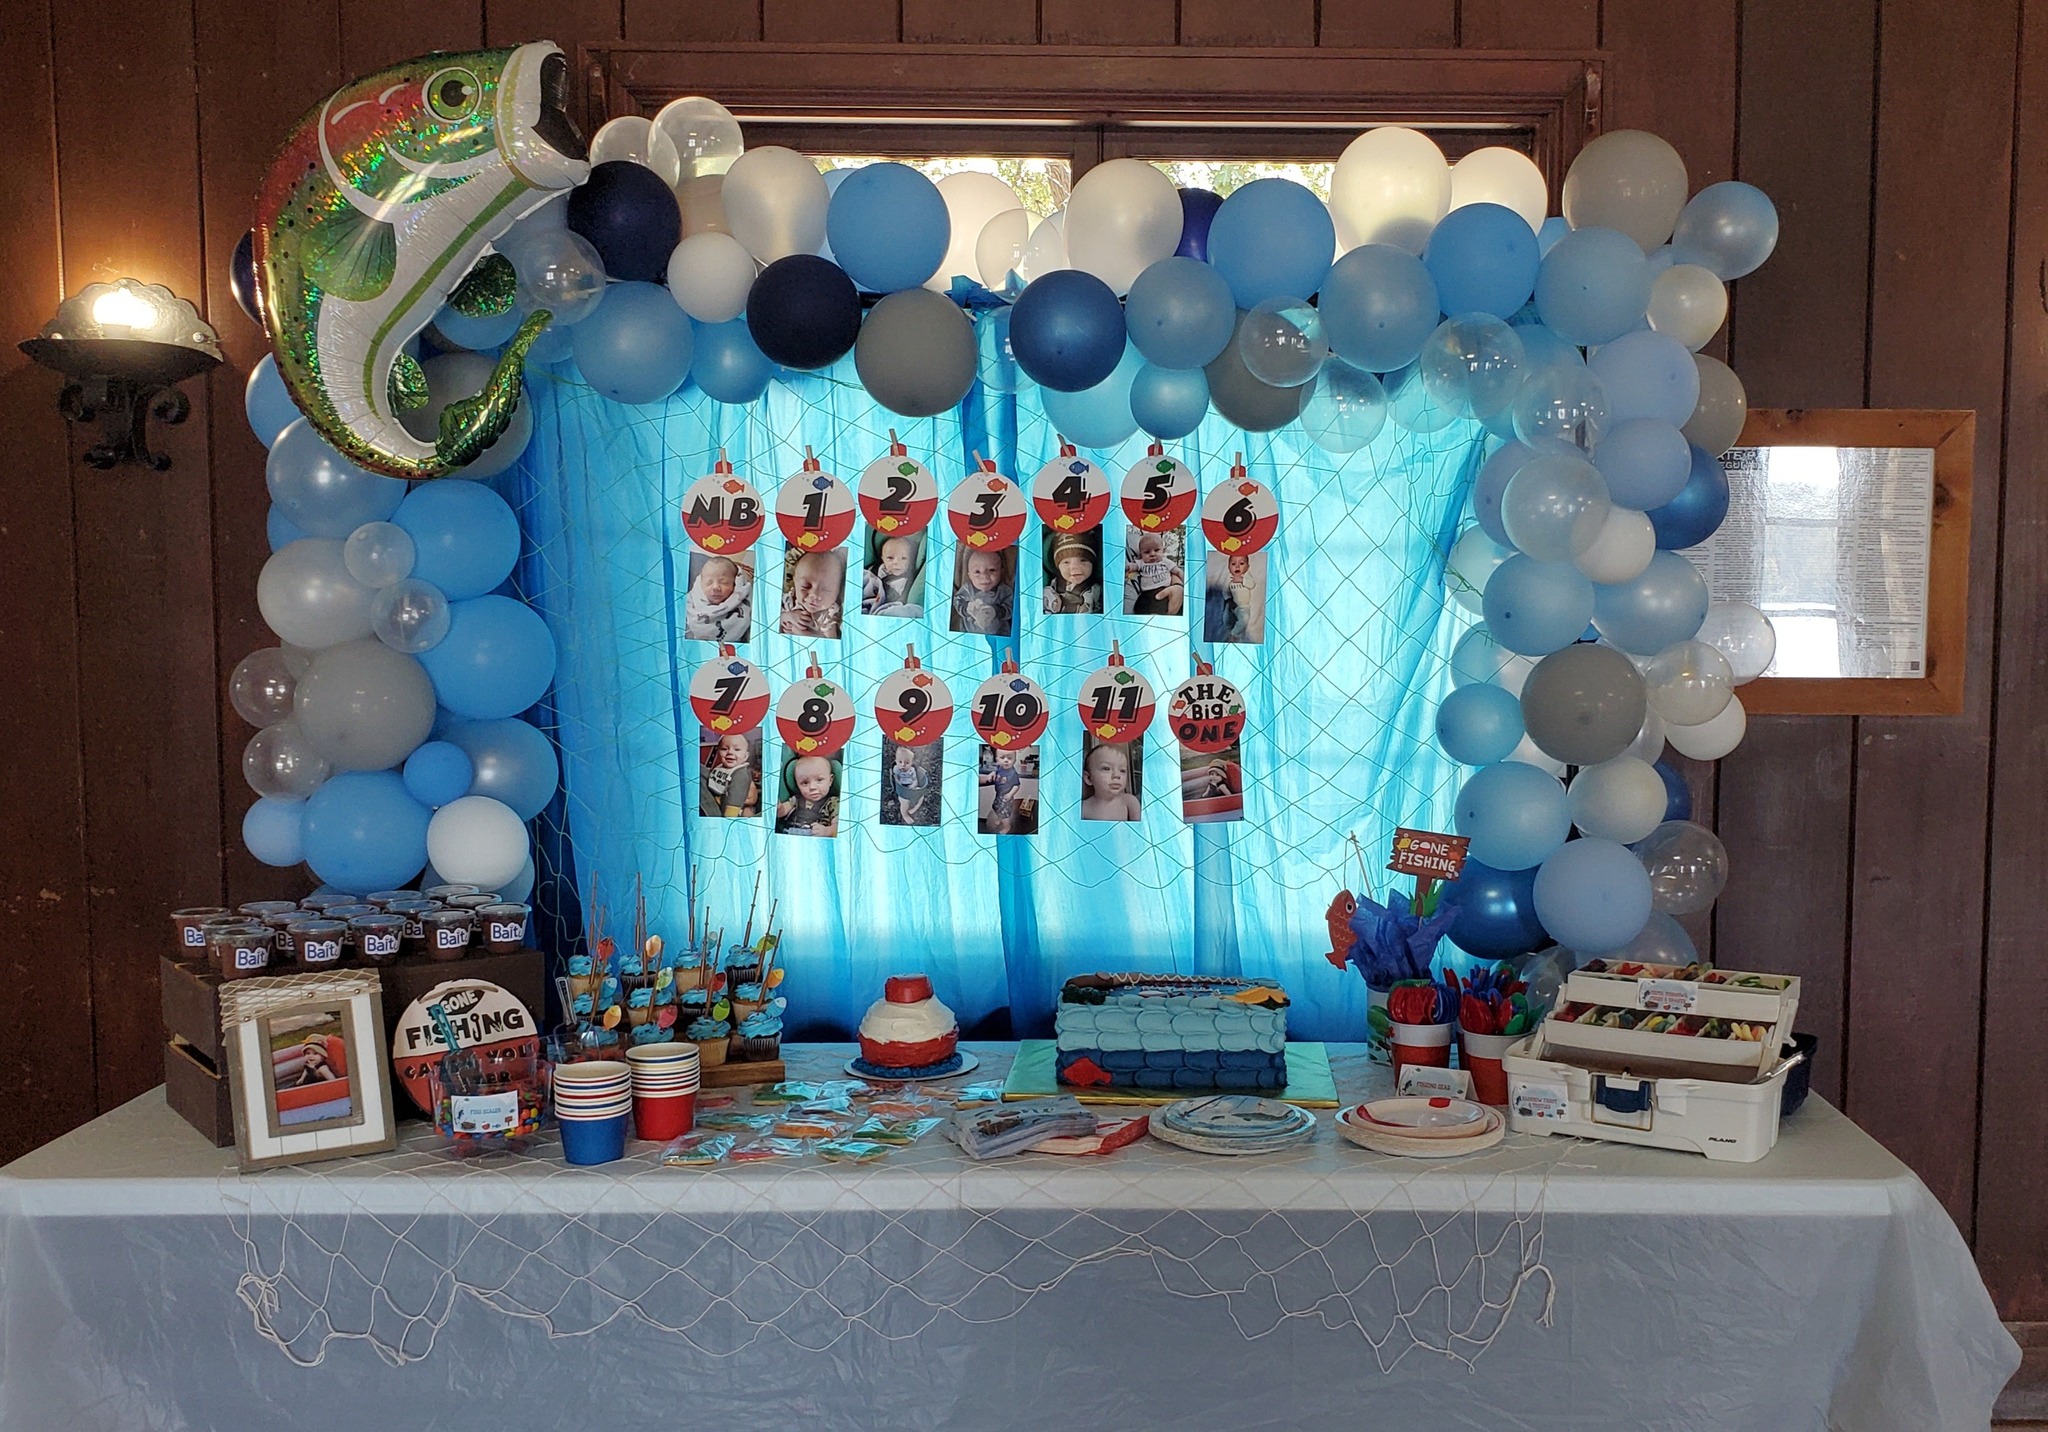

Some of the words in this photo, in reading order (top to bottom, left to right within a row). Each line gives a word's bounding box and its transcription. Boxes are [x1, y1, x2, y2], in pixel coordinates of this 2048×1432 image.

[687, 493, 761, 531] NB
[802, 492, 828, 531] 1
[879, 477, 917, 515] 2
[968, 493, 1006, 531] 3
[1051, 476, 1091, 513] 4
[1141, 474, 1176, 513] 5
[1223, 497, 1256, 535] 6
[710, 676, 751, 715] 7
[899, 688, 933, 725] 9
[978, 693, 1042, 731] 10
[1091, 686, 1144, 723] 11
[1178, 683, 1235, 705] THE
[798, 698, 834, 736] 8
[1178, 721, 1239, 744] ONE
[1398, 851, 1457, 872] FISHING
[186, 929, 204, 943] Ba
[307, 942, 335, 958] Bait
[367, 936, 395, 952] Bait
[439, 931, 466, 947] Bait
[492, 924, 519, 940] Bait
[238, 950, 266, 967] Bait
[440, 991, 479, 1014] GONE
